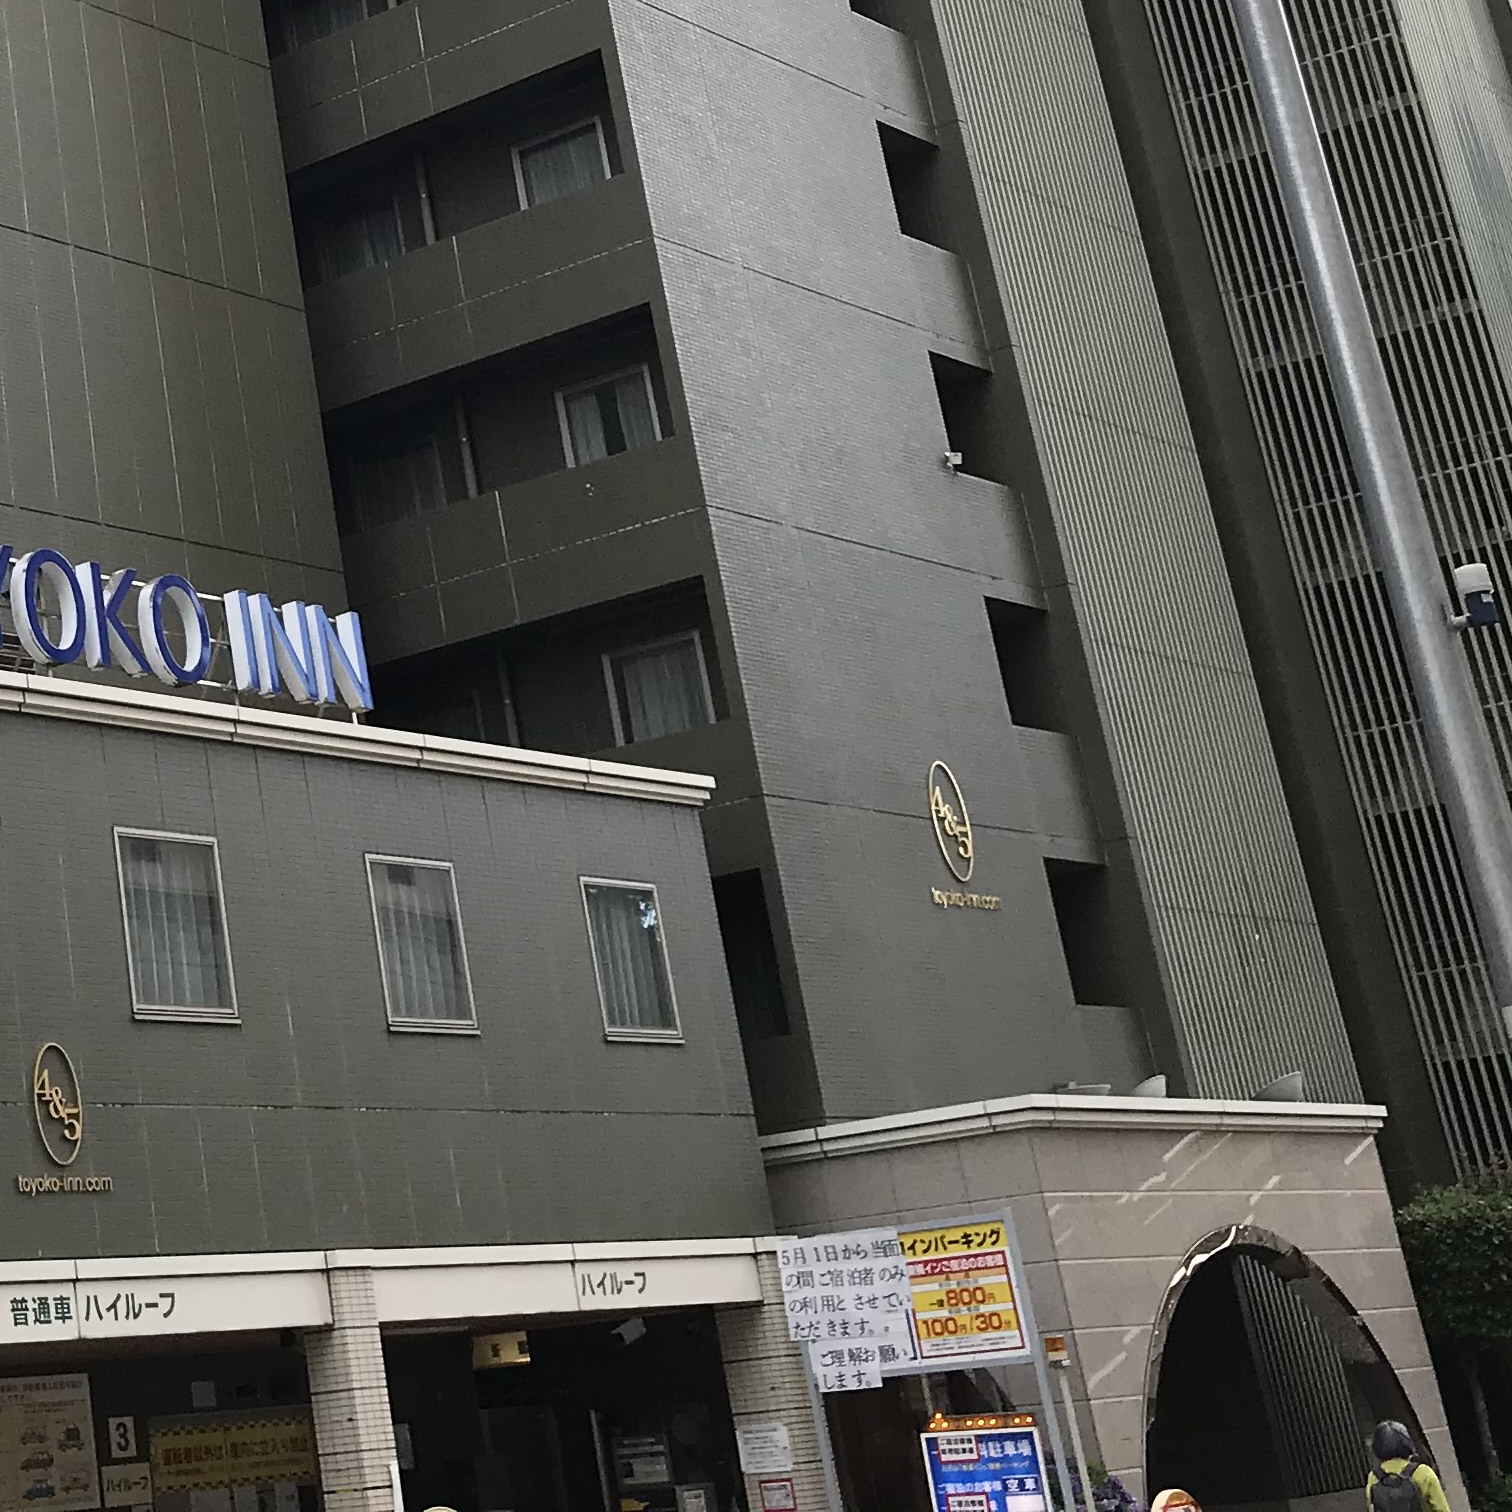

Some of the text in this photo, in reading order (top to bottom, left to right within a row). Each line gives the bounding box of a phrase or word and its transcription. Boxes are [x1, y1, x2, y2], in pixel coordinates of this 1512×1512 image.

[224, 589, 374, 713] INN
[18, 1174, 113, 1196] toyoko-inn.com
[581, 1271, 646, 1296] ハイルーフ
[9, 1290, 176, 1327] 普通車 ハイルーフ
[115, 1422, 130, 1452] 3
